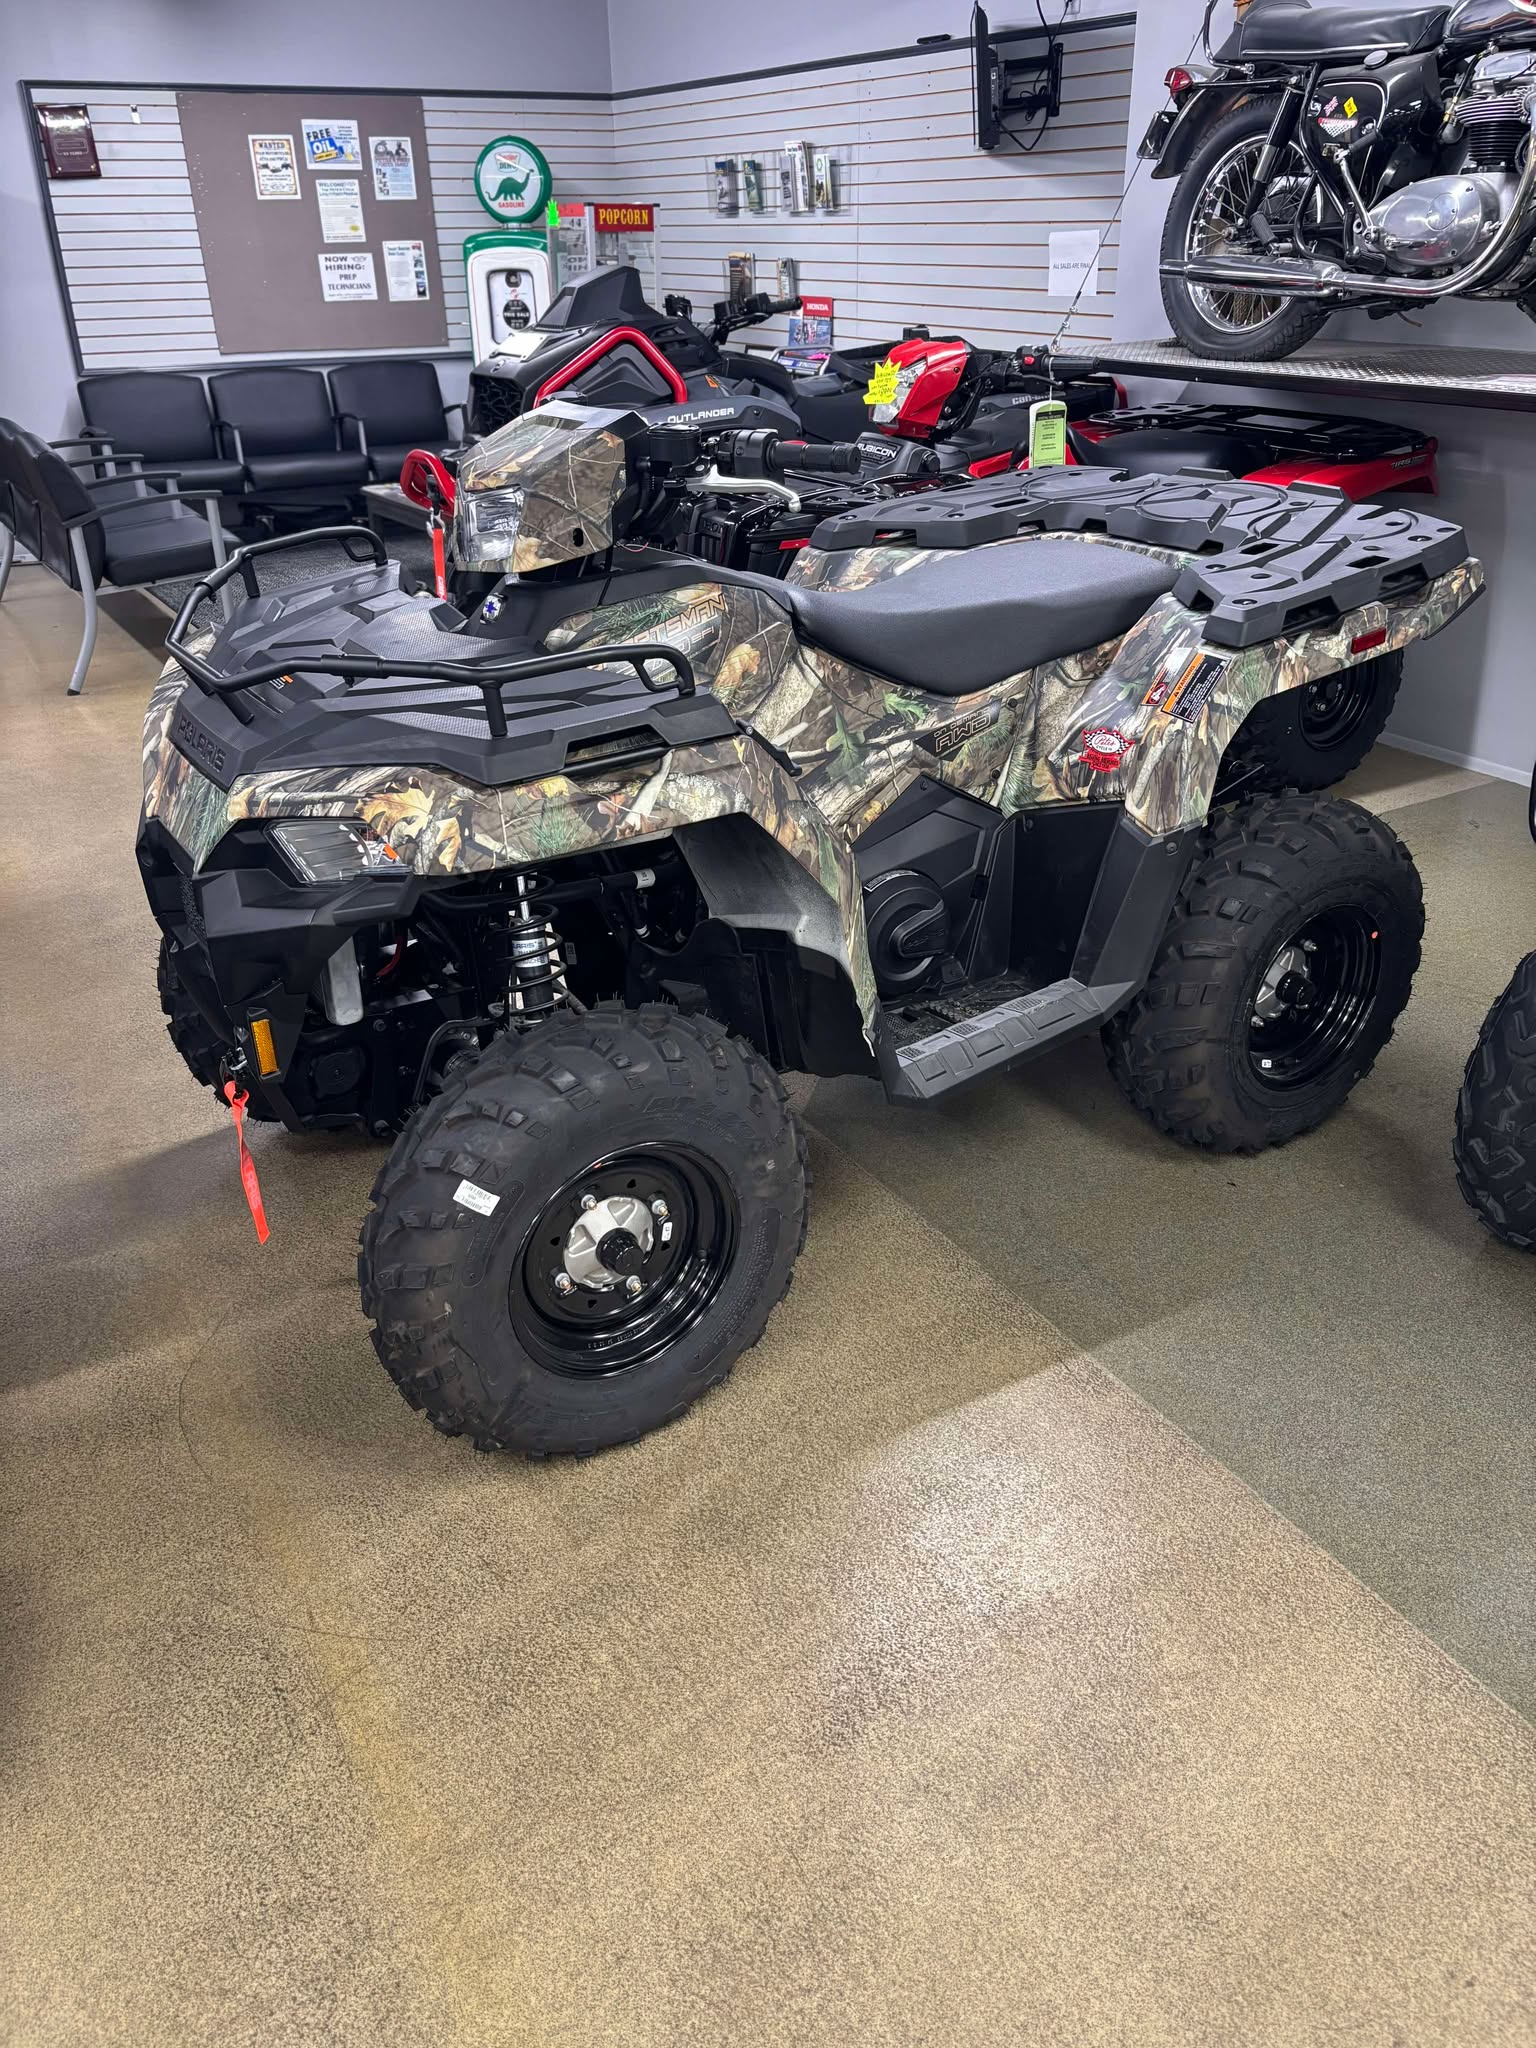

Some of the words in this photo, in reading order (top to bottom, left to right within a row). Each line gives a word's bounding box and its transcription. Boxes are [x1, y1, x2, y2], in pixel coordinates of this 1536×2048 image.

[306, 127, 331, 141] FREE
[598, 208, 649, 225] POPCORN
[806, 303, 829, 311] HONDA
[667, 407, 735, 423] OUTLANDER
[857, 443, 897, 458] RUBICON
[1176, 664, 1196, 692] WARNING
[935, 713, 991, 753] AWD
[178, 715, 227, 773] POLARIS
